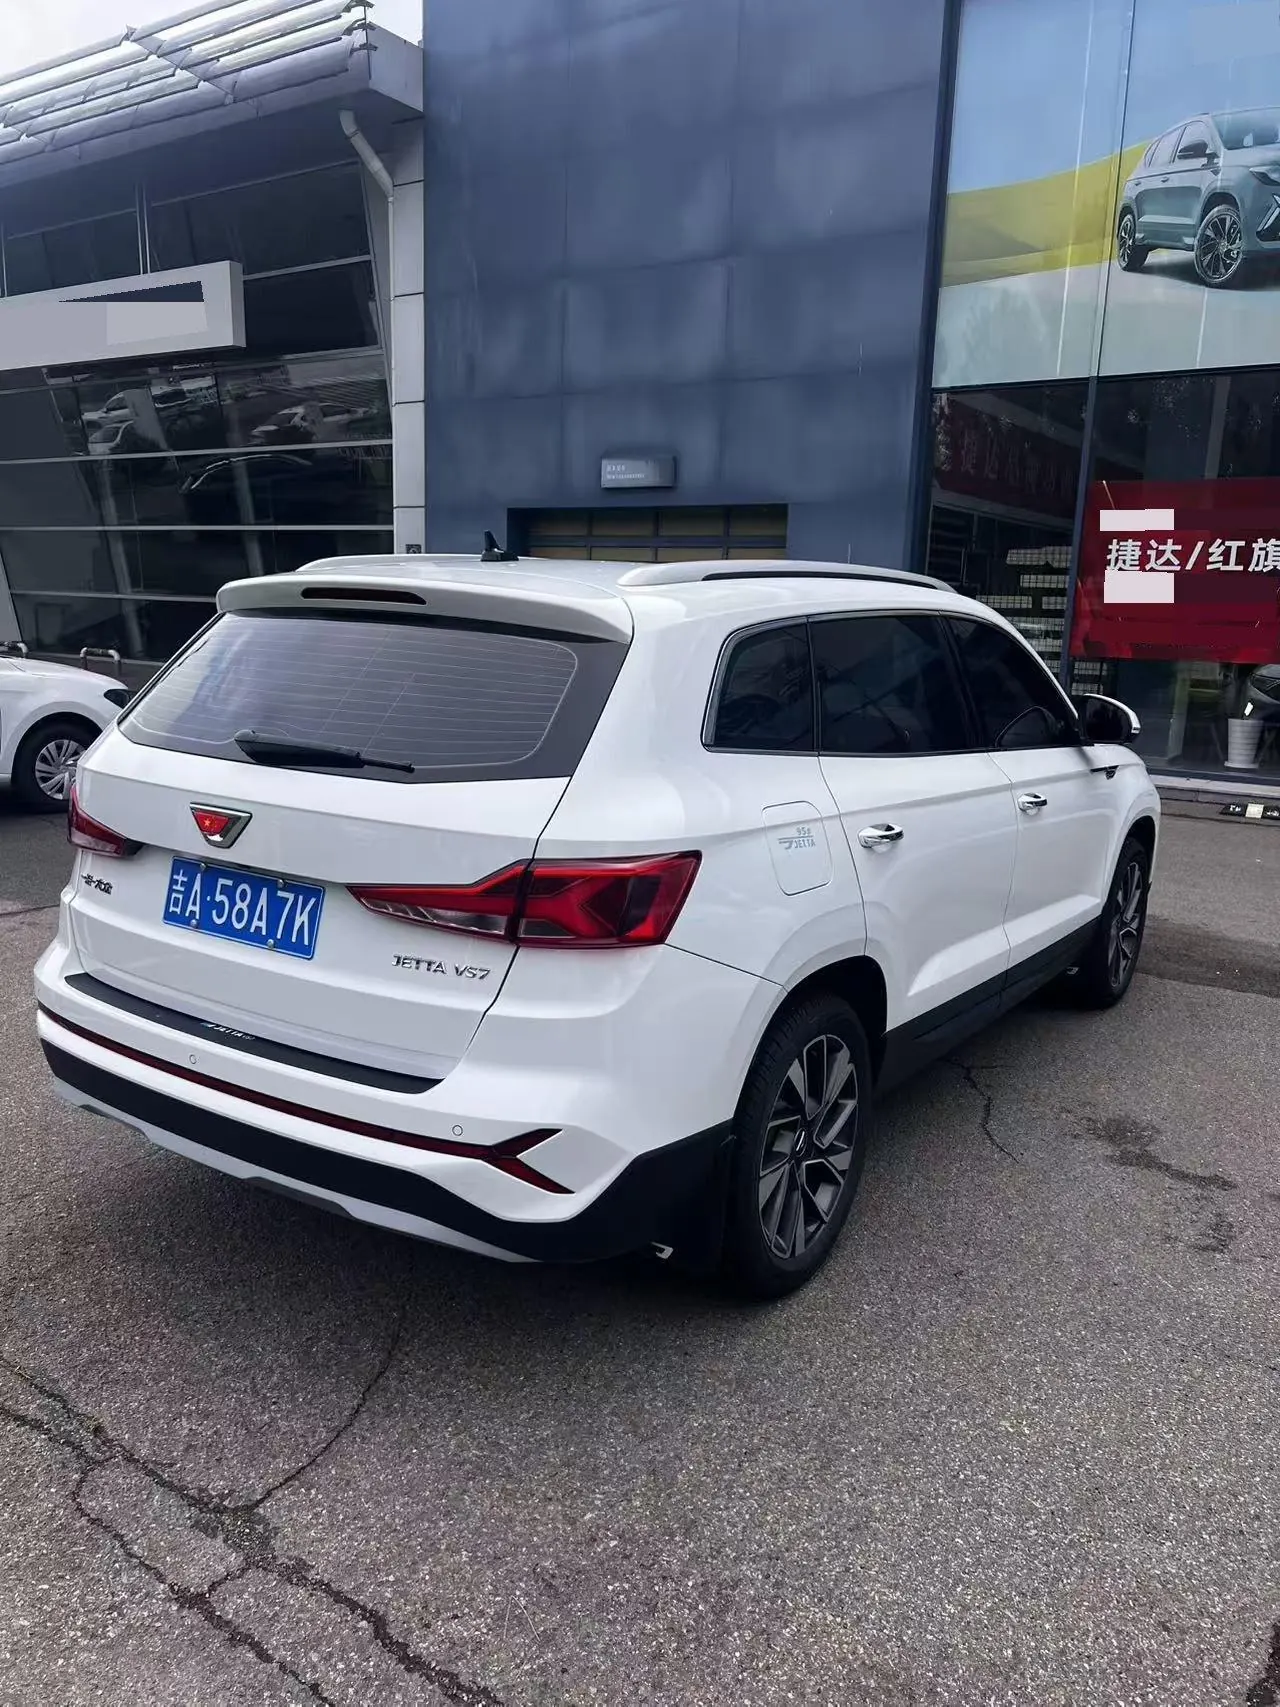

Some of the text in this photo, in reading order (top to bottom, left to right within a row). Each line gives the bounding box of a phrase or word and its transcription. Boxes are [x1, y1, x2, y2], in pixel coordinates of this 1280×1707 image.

[1106, 538, 1280, 573] 捷达/红旗
[391, 955, 491, 980] JETTA VS7
